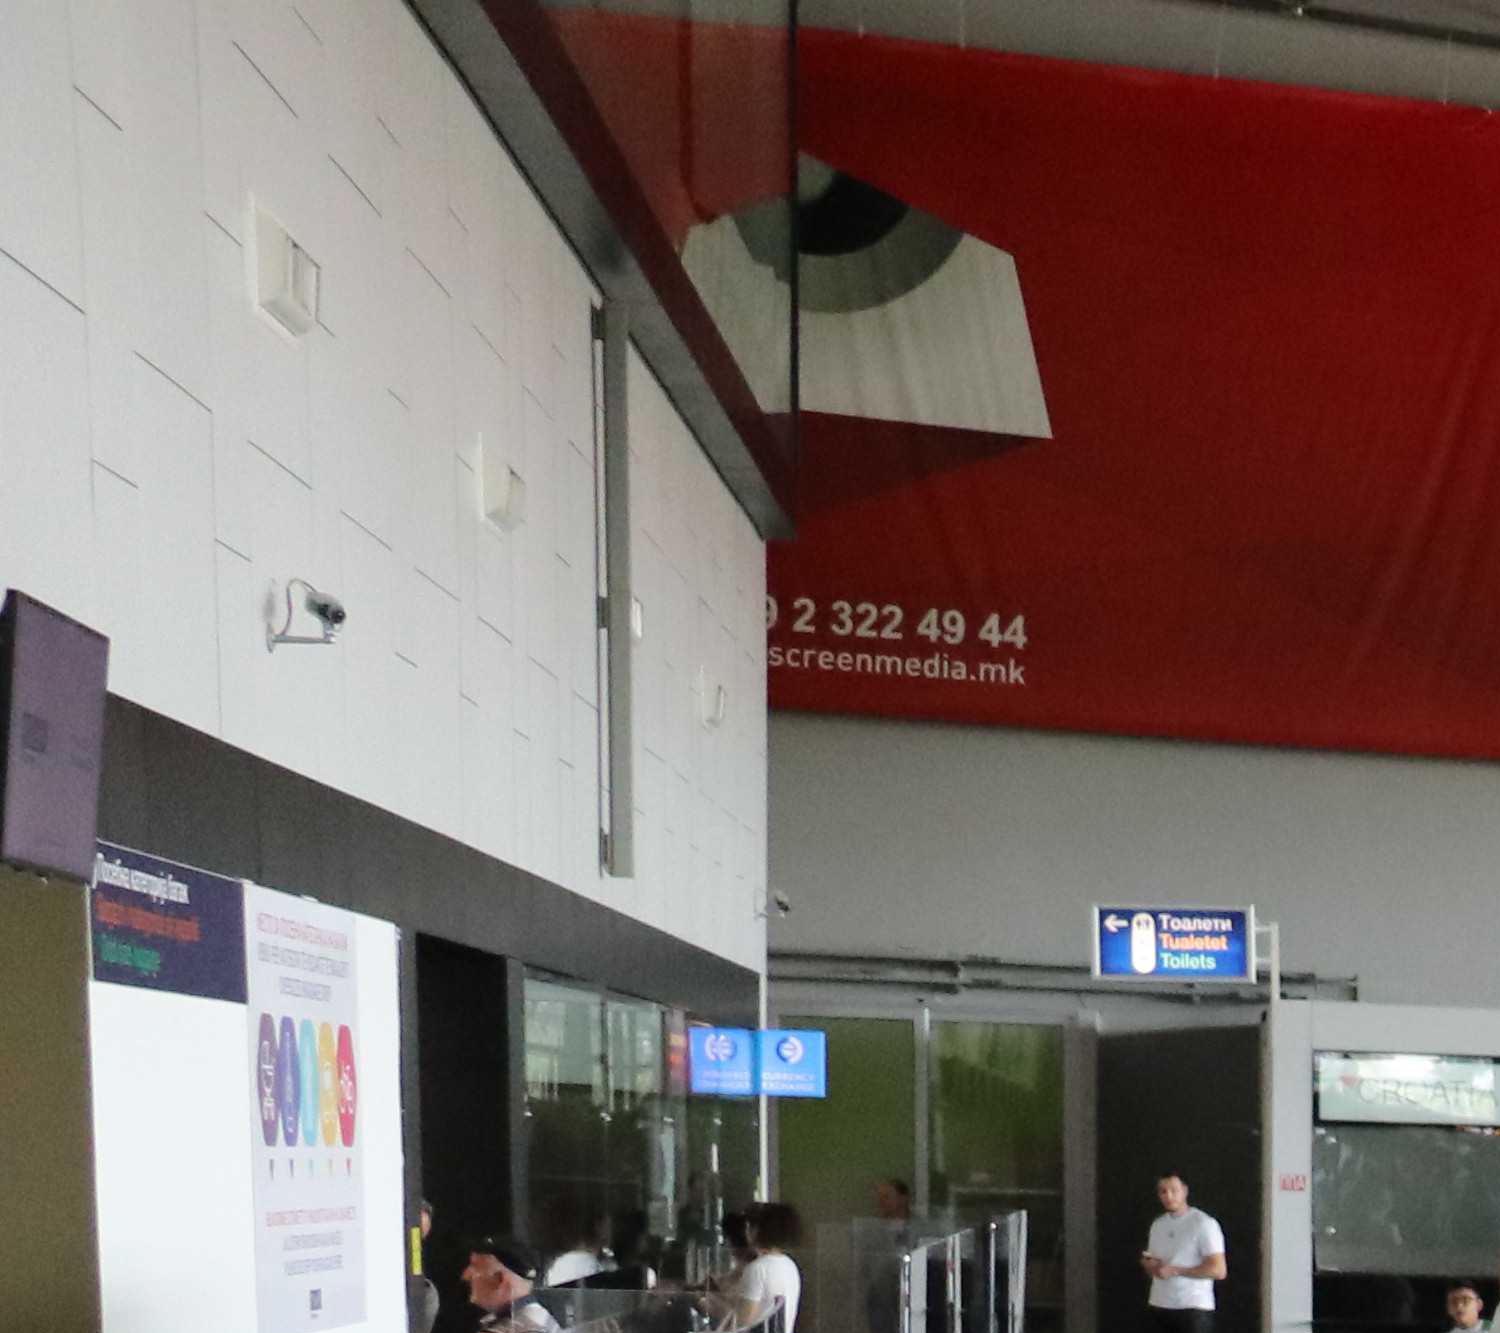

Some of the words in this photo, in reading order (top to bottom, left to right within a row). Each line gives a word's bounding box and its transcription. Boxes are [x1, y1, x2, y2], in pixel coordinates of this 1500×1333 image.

[792, 597, 816, 634] 2
[831, 600, 904, 640] 322
[917, 607, 966, 645] 49
[978, 612, 1028, 650] 44
[768, 646, 1026, 686] screenmedia.mk
[1159, 913, 1232, 932] Тоалети
[1160, 933, 1228, 950] Tualetet
[1160, 952, 1216, 970] Toilets
